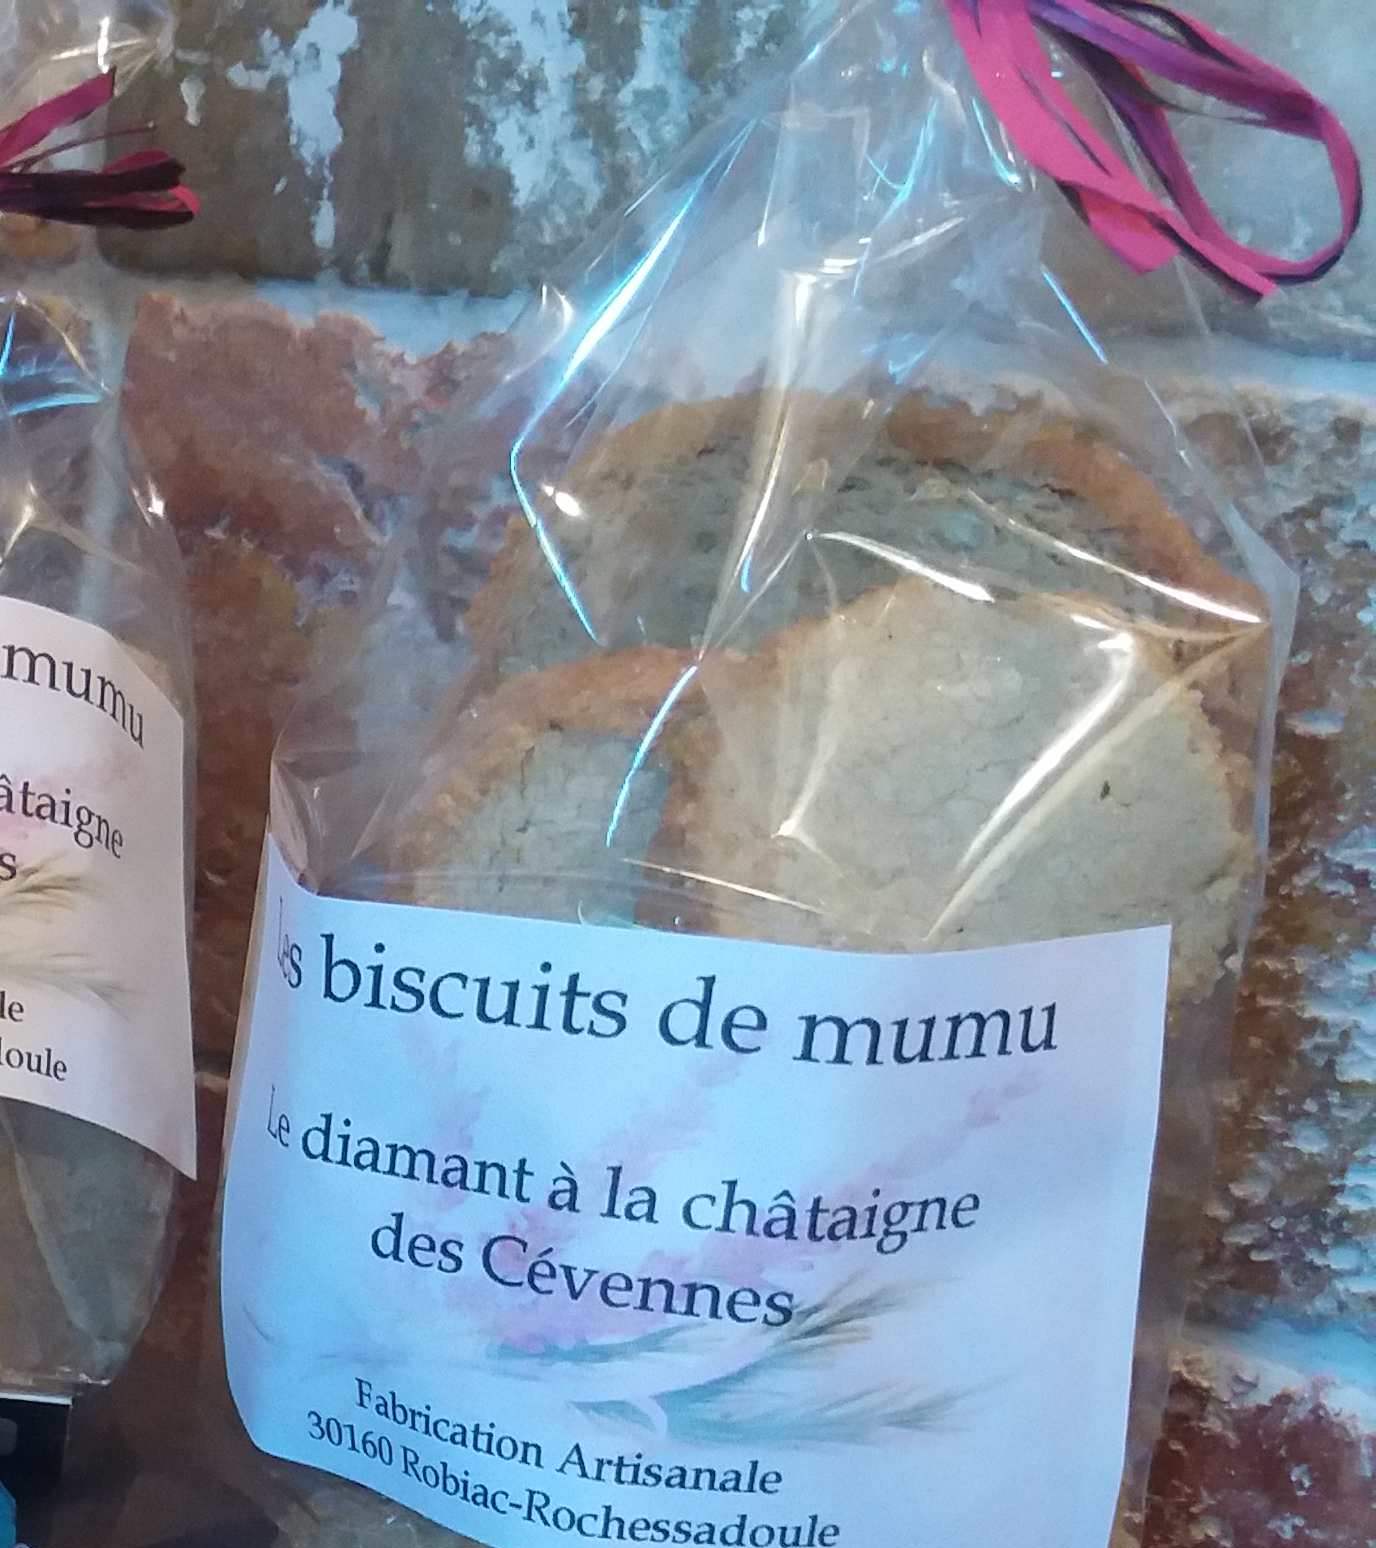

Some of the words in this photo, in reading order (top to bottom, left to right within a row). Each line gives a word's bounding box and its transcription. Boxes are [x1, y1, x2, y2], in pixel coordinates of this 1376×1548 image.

[0, 643, 145, 750] mumu
[320, 932, 629, 1041] biscuits
[657, 975, 769, 1055] de
[792, 1000, 1059, 1068] mumu
[267, 1083, 291, 1149] Le
[301, 1110, 532, 1202] diamant
[548, 1160, 581, 1214] à
[600, 1165, 657, 1226] la
[680, 1179, 982, 1256] châtaigne
[370, 1213, 464, 1276] des
[482, 1233, 796, 1329] Cévennes
[306, 1410, 395, 1468] 30160
[354, 1376, 544, 1472] Fabrication
[557, 1442, 784, 1496] Artisanale
